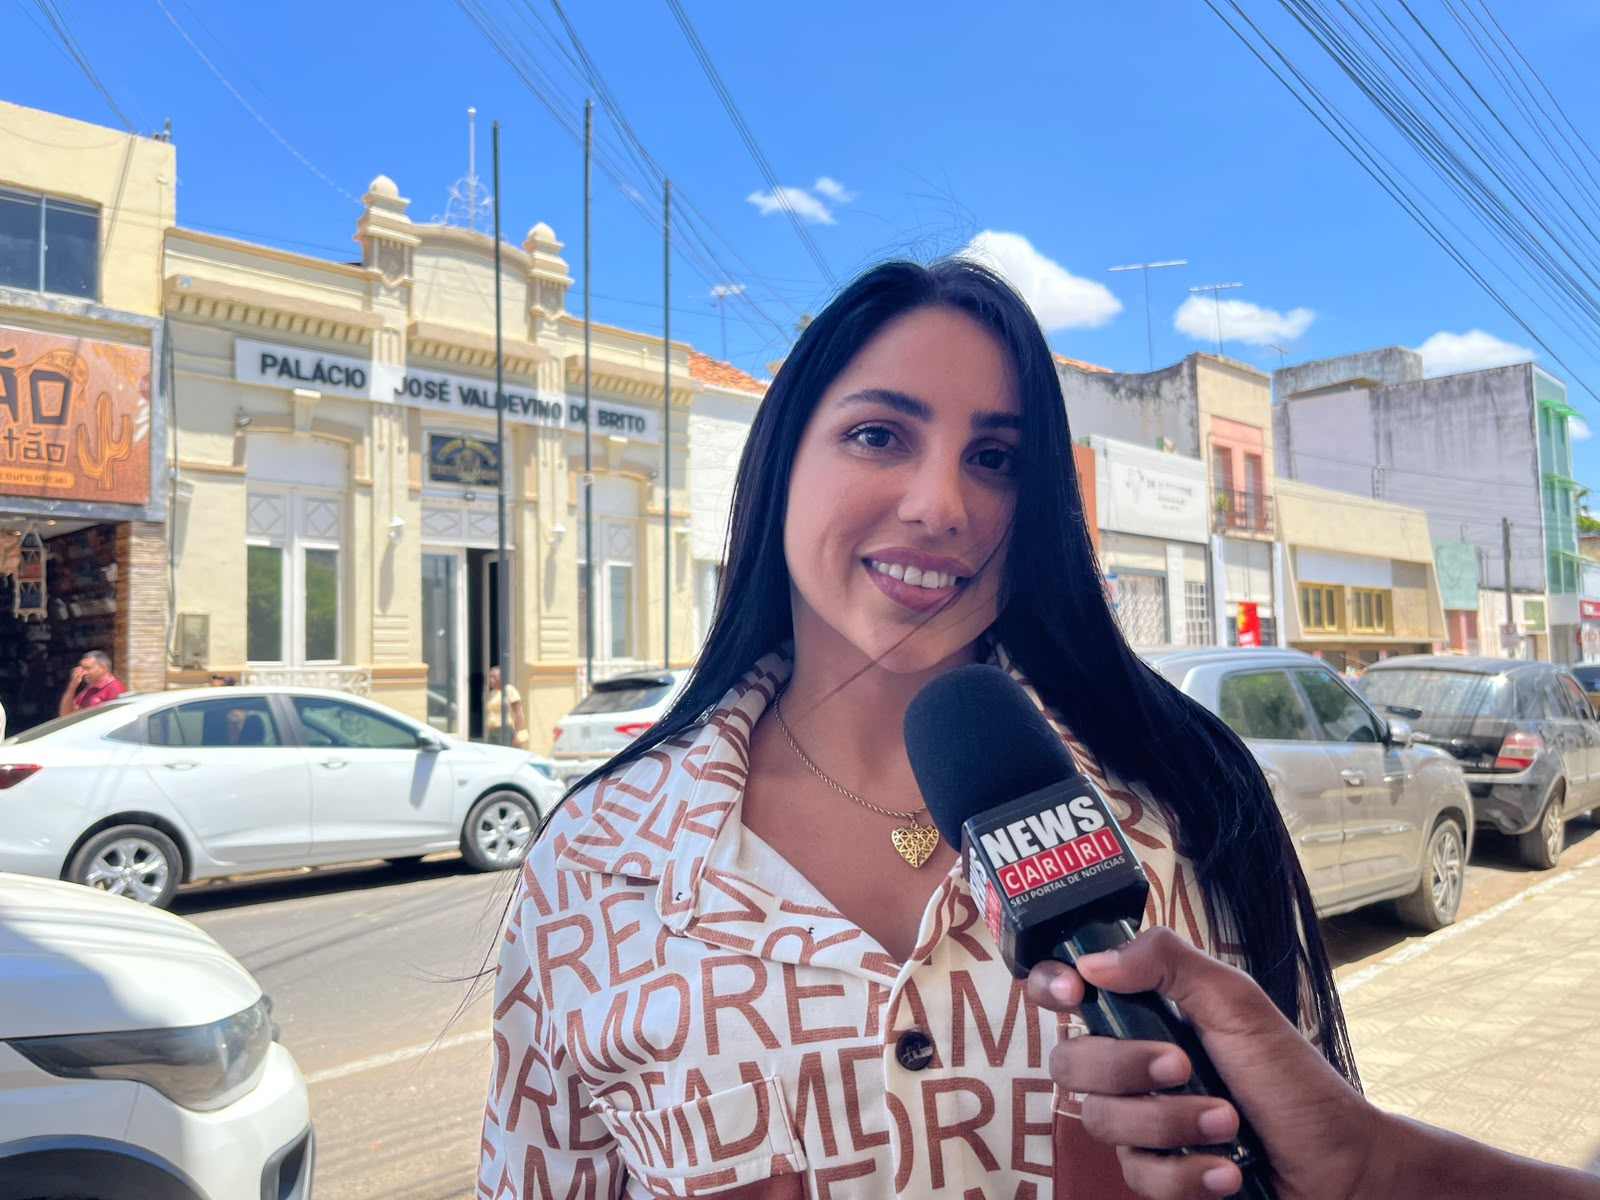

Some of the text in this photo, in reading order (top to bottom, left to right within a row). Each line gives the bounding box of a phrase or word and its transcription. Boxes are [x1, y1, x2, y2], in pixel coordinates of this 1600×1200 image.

[260, 353, 367, 389] PALÁCIO
[394, 376, 450, 403] JOSÉ
[597, 409, 646, 434] BRITO
[979, 795, 1105, 869] NEWS
[1005, 834, 1113, 890] CARIRI
[1010, 856, 1126, 908] SEU PORTAL DE NOTÍCIAS
